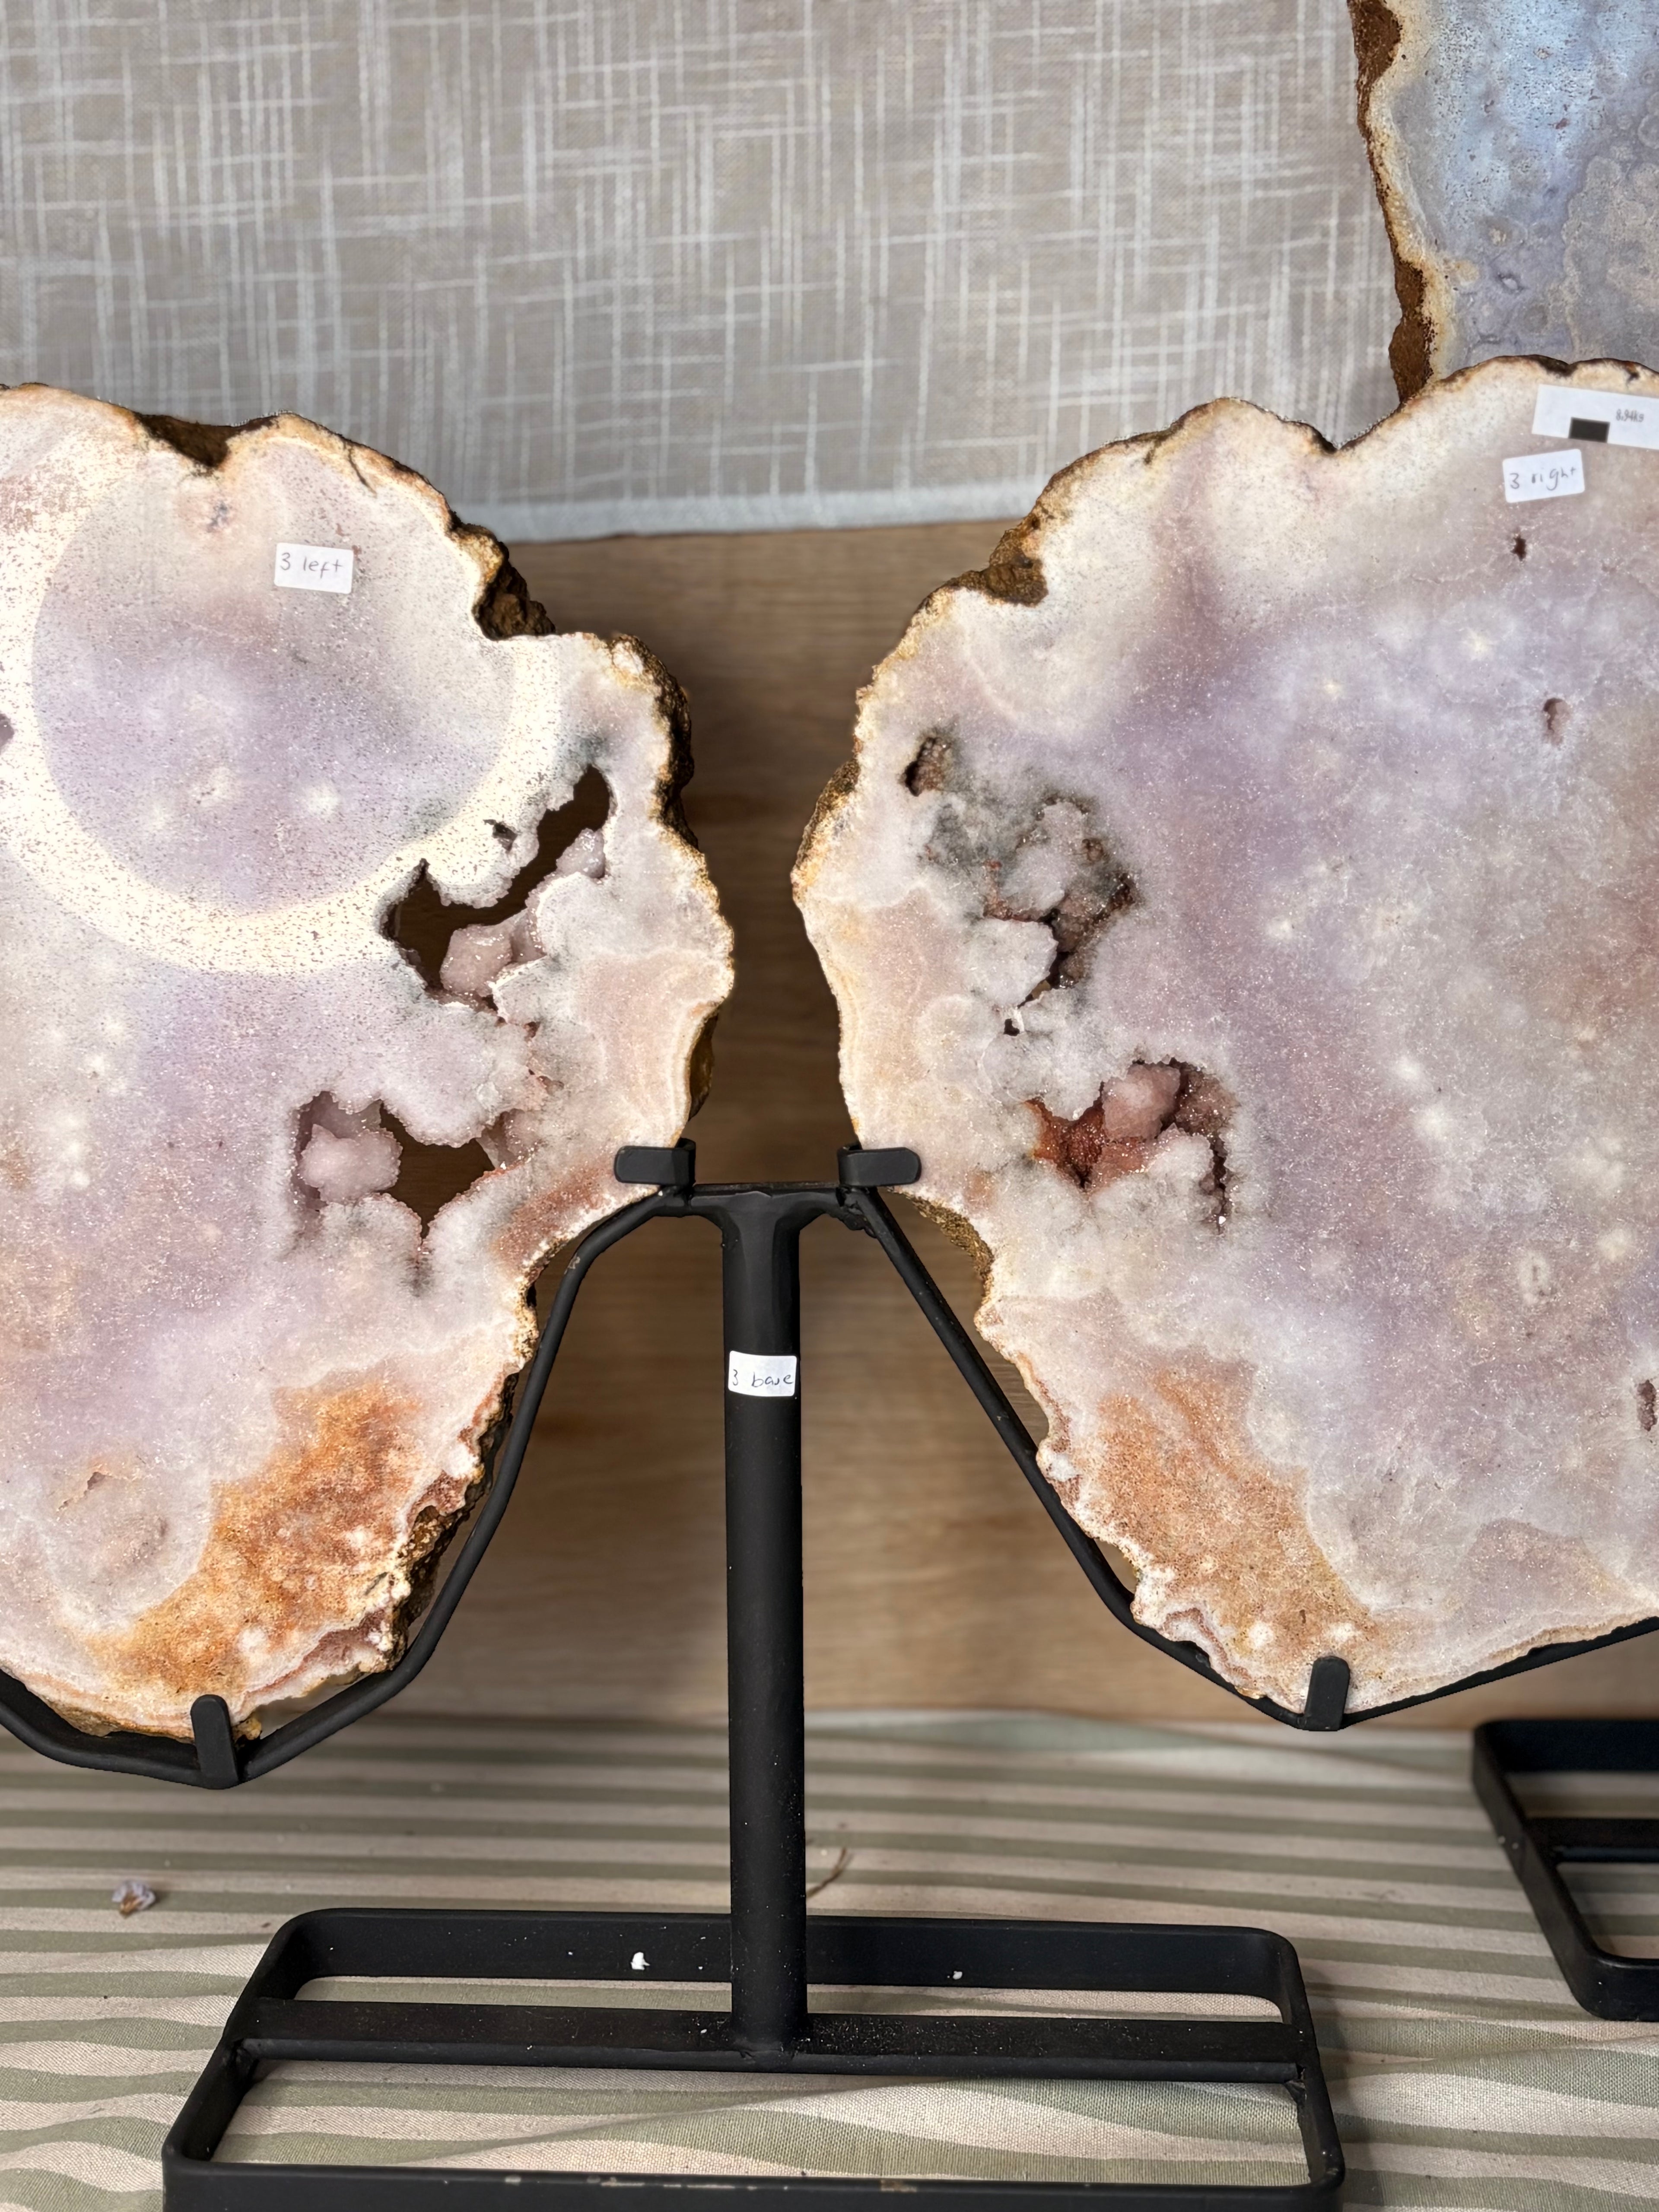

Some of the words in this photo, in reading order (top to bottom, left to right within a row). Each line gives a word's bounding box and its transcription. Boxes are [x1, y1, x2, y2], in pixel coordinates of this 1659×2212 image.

[1510, 473, 1520, 489] 3
[1532, 467, 1576, 491] right
[280, 552, 290, 571] 3
[303, 556, 343, 578] left
[732, 1369, 738, 1386] 3
[751, 1371, 794, 1388] base
